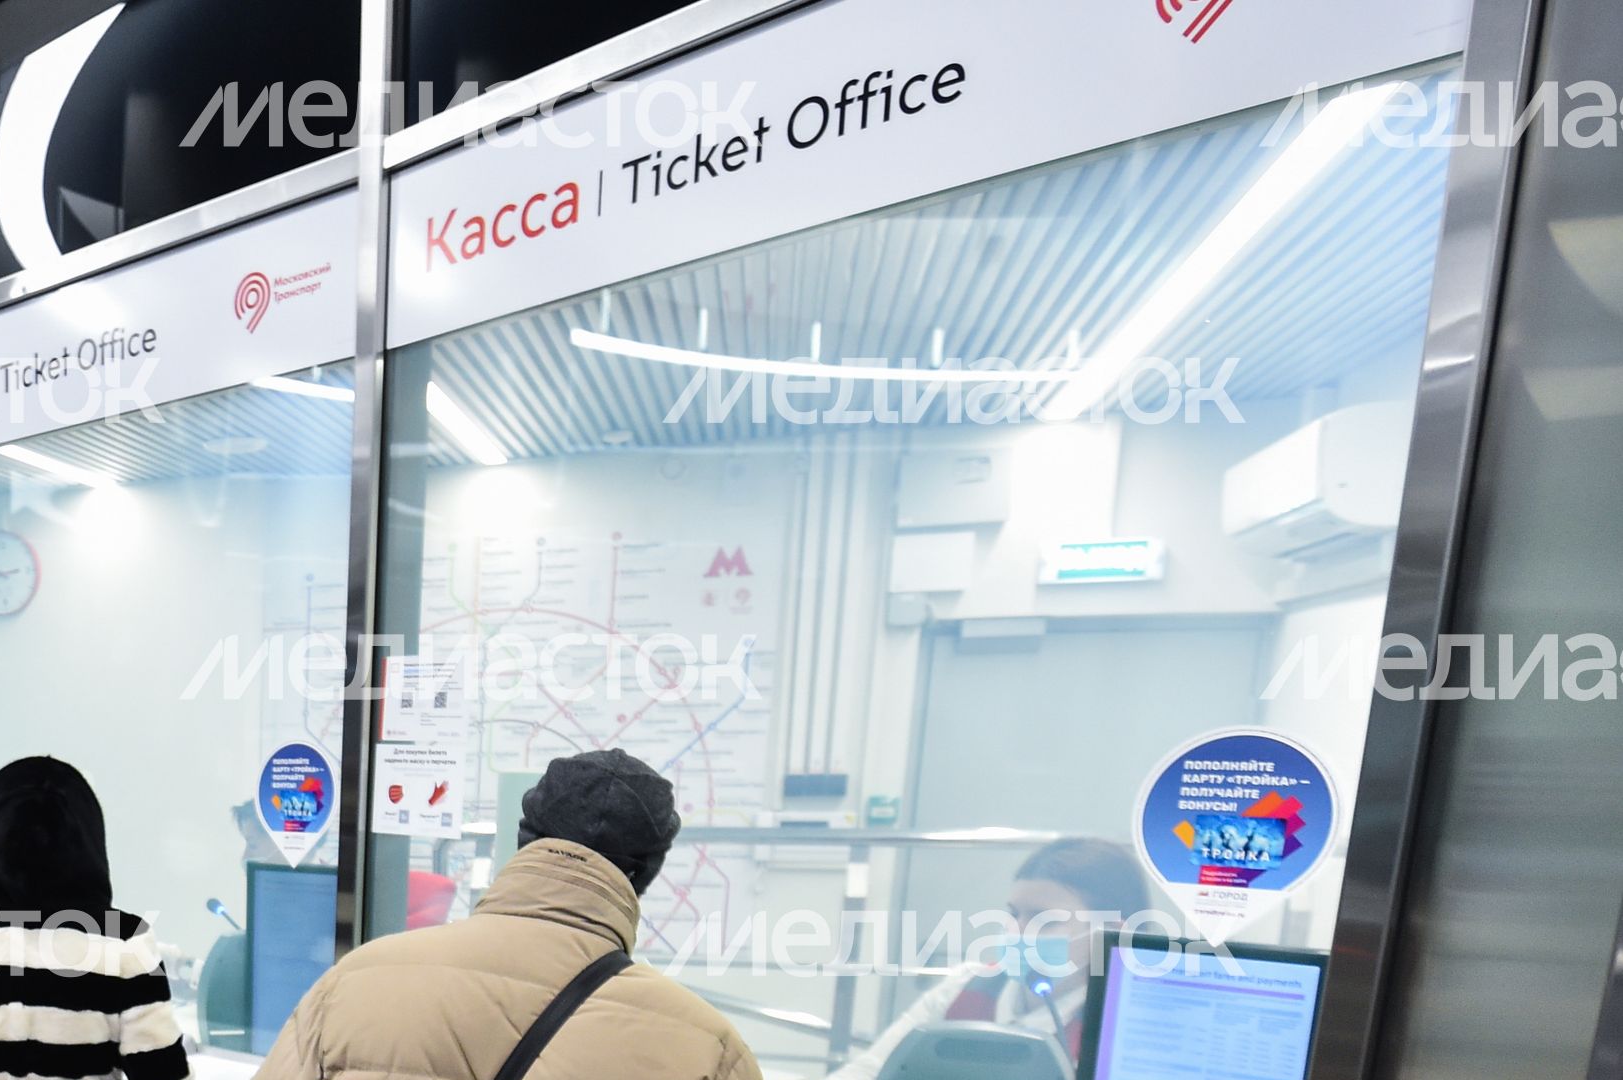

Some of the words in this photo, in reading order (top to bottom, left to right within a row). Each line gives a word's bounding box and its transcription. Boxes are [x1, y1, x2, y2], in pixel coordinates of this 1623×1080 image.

[425, 181, 581, 273] Касса
[621, 116, 771, 204] Ticket
[786, 62, 967, 149] Office
[274, 262, 331, 287] Московский
[274, 281, 322, 304] Транспорт
[0, 347, 70, 394] Ticket
[78, 325, 157, 371] Office
[1184, 760, 1275, 772] ПОПОЛНЯЙТЕ
[1182, 774, 1225, 784] КАРТУ
[1180, 786, 1260, 799] ПОЛУЧАЙТЕ
[1178, 800, 1238, 811] БОНУСЫ!
[1201, 847, 1271, 863] ТРОЙКА
